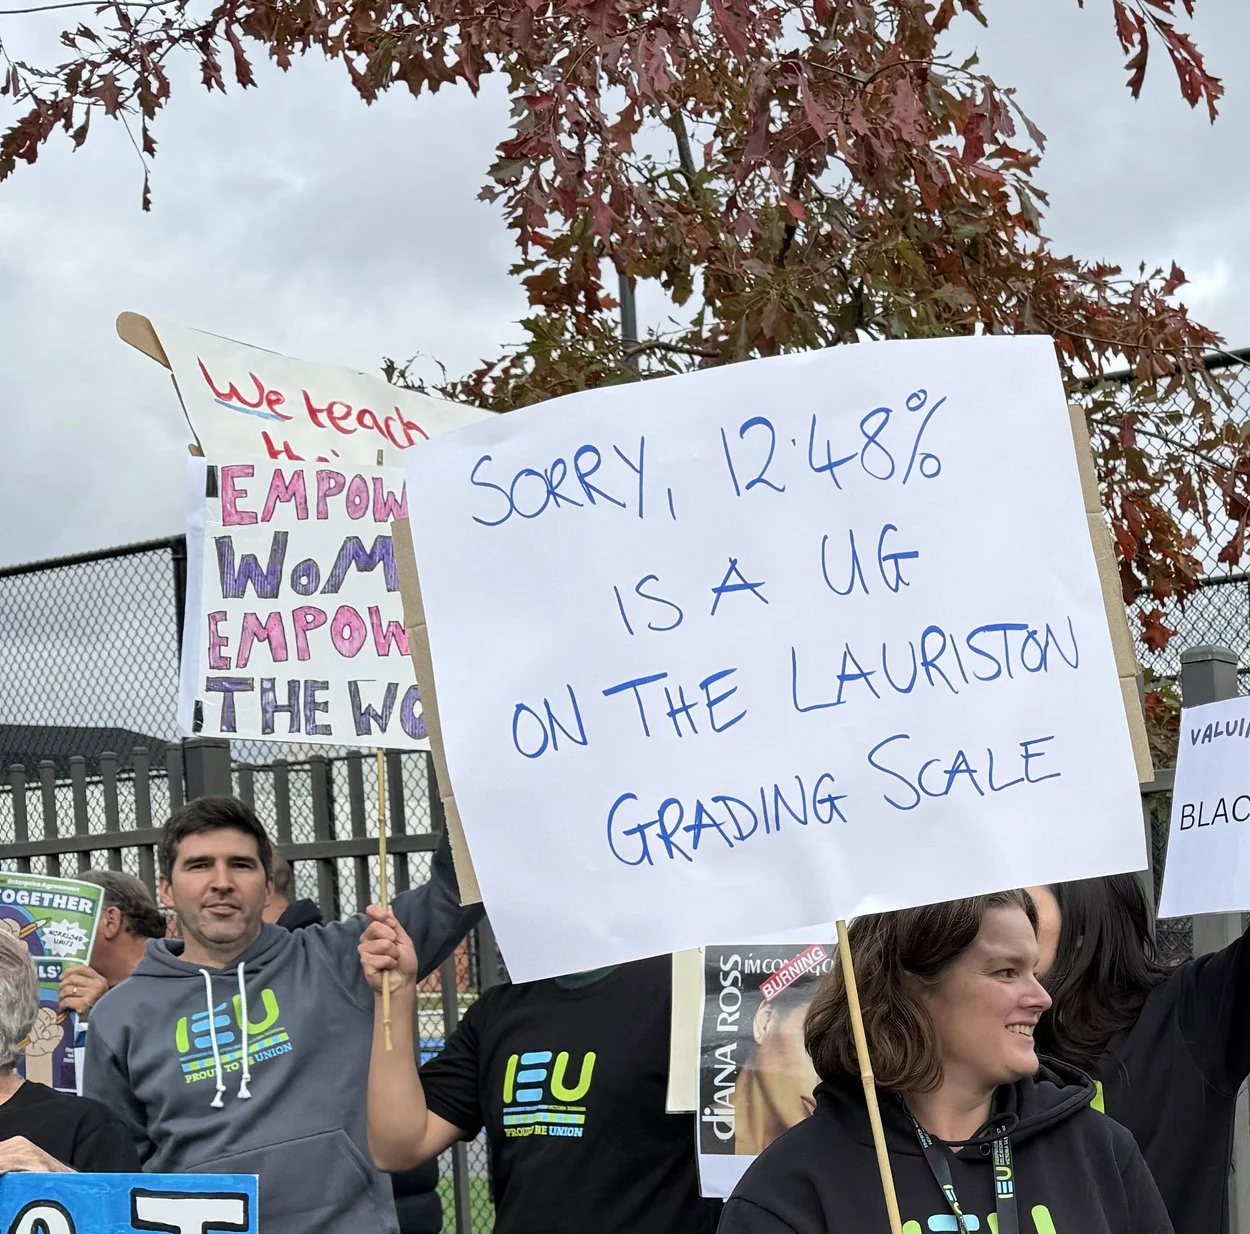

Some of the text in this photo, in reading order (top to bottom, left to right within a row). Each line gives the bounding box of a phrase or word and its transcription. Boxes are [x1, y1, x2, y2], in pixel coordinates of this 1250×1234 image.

[197, 356, 292, 421] We
[302, 390, 429, 450] teach
[470, 435, 677, 527] SORRY,
[613, 523, 920, 635] IS A UG
[205, 677, 332, 735] THE
[511, 616, 1080, 759] ON THE LAURISTON
[606, 733, 1062, 869] GRADING SCALE
[0, 888, 93, 914] OGETHER
[717, 953, 742, 1032] ROSS
[762, 946, 825, 999] BURNING
[176, 988, 280, 1053] IEU
[184, 1067, 218, 1084] PROU
[254, 1043, 293, 1062] UNION
[503, 1051, 597, 1104] IEU
[549, 1126, 584, 1137] UNION
